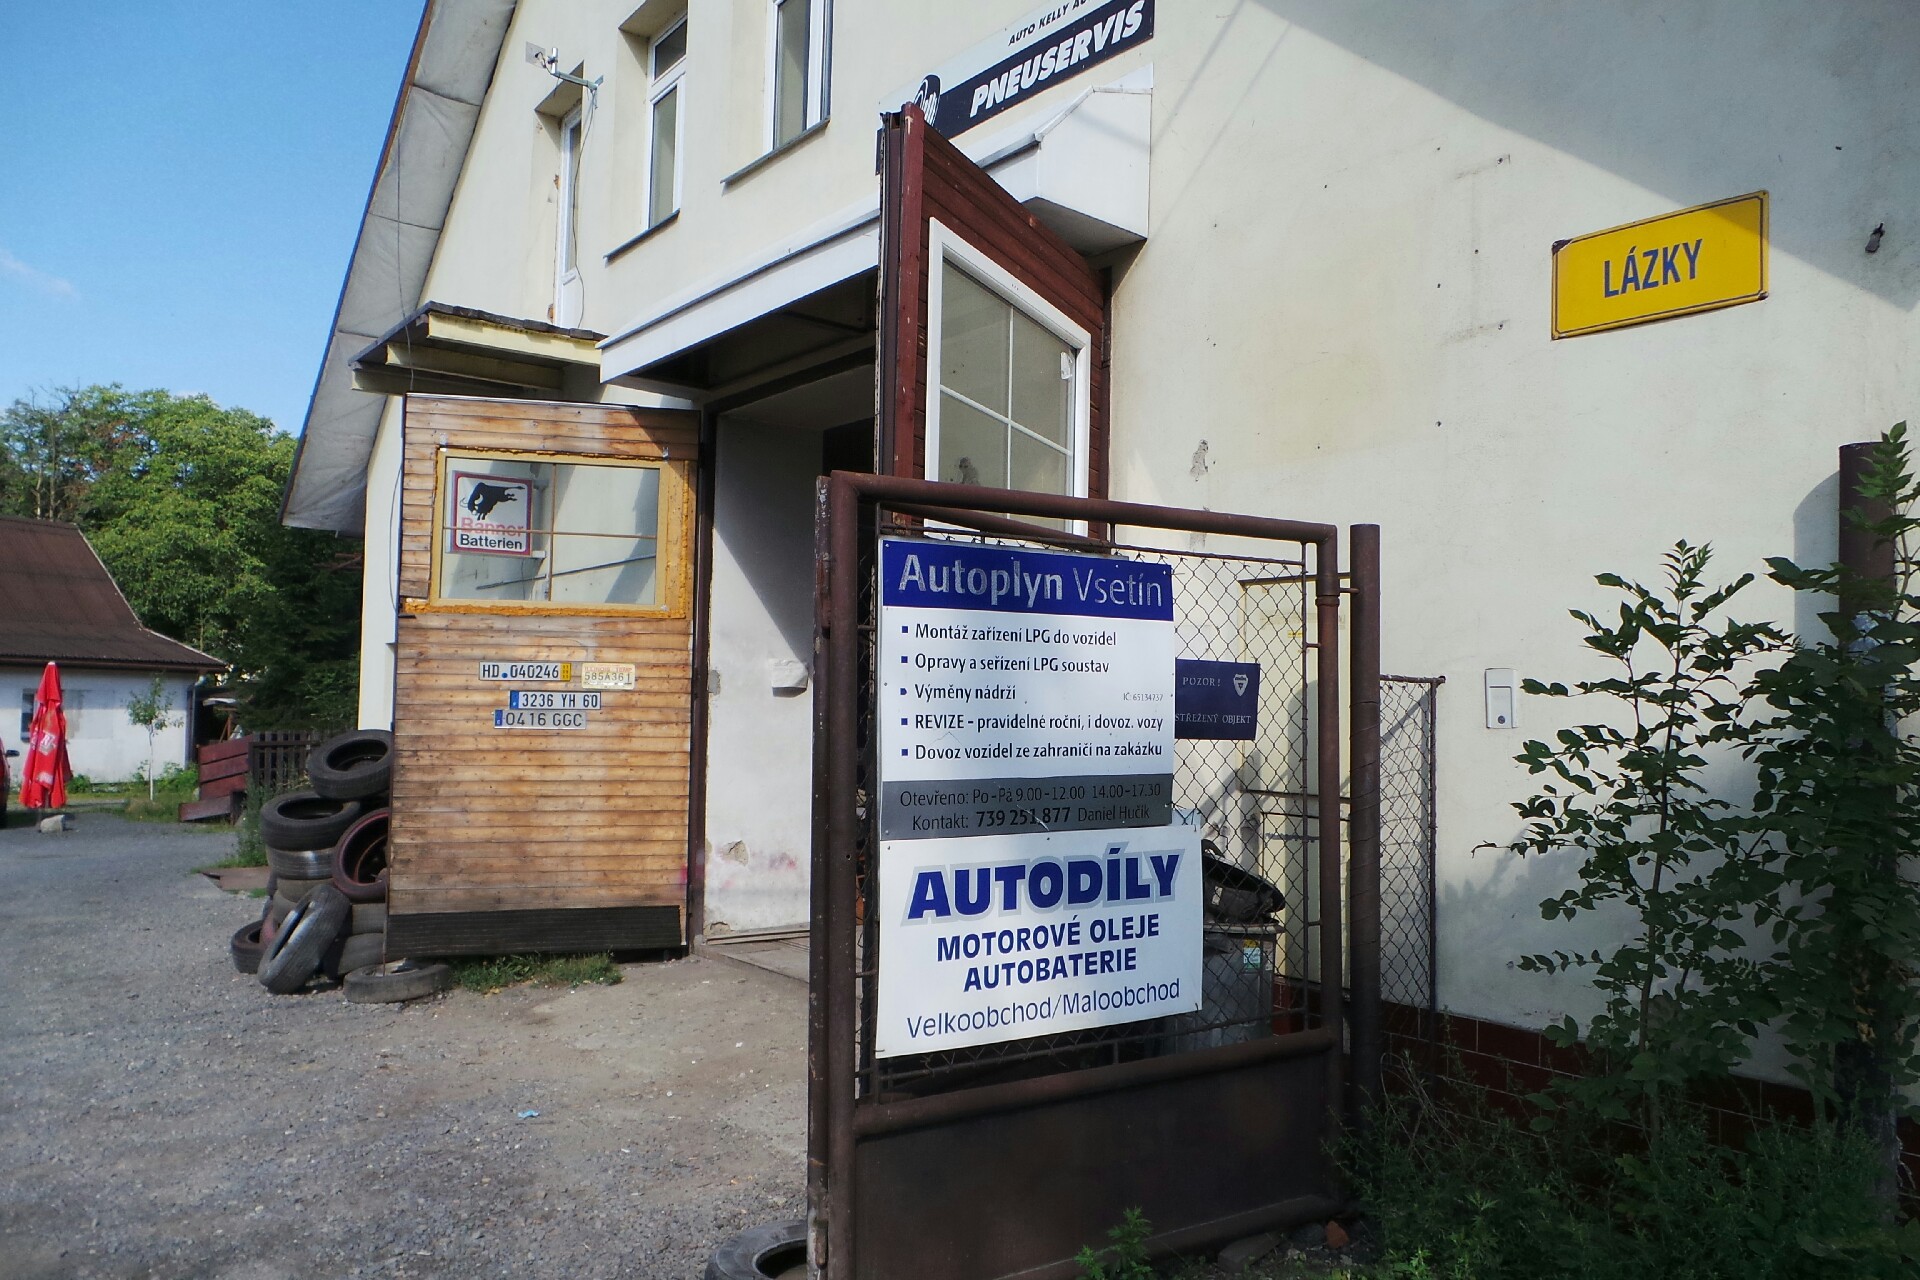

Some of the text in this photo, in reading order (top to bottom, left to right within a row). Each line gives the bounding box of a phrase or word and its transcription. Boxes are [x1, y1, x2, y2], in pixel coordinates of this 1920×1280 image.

[1008, 23, 1036, 46] AUTO
[1039, 3, 1069, 29] KELLY
[970, 0, 1145, 118] PNEUSERVIS
[1603, 238, 1703, 298] LÁZKY
[460, 533, 523, 550] Batterien
[898, 554, 1162, 607] Autoplyn Vsetín
[915, 624, 1117, 646] Montáž zařízení LPG do vozidel
[482, 664, 500, 679] HD
[915, 653, 1110, 673] Opravy a seřízení LPG soustav
[522, 693, 598, 708] 3236 YH 60
[915, 683, 1016, 703] Výměny nádrží
[505, 712, 583, 727] 0416 GGC
[915, 714, 965, 729] REVIZE
[977, 713, 1046, 733] pravidelné
[1049, 714, 1085, 731] roční,
[1088, 714, 1092, 729] i
[1094, 713, 1134, 729] dovoz.
[1137, 716, 1164, 732] vozy
[1222, 714, 1252, 725] OBJEKT
[915, 742, 1162, 760] Dovoz vozidel ze zahraničí na zakázku
[900, 790, 969, 807] Otevřeno:
[912, 812, 969, 831] Kontakt:
[976, 810, 1006, 828] 739
[1009, 808, 1037, 826] 251
[1042, 806, 1071, 824] 877
[1078, 805, 1116, 822] Daniel
[905, 844, 1182, 922] AUTODÍLY
[937, 913, 1160, 962] MOTOROVÉ OLEJE
[964, 947, 1137, 992] AUTOBATERIE
[907, 978, 1180, 1039] Velkoobchod/Maloobchod
